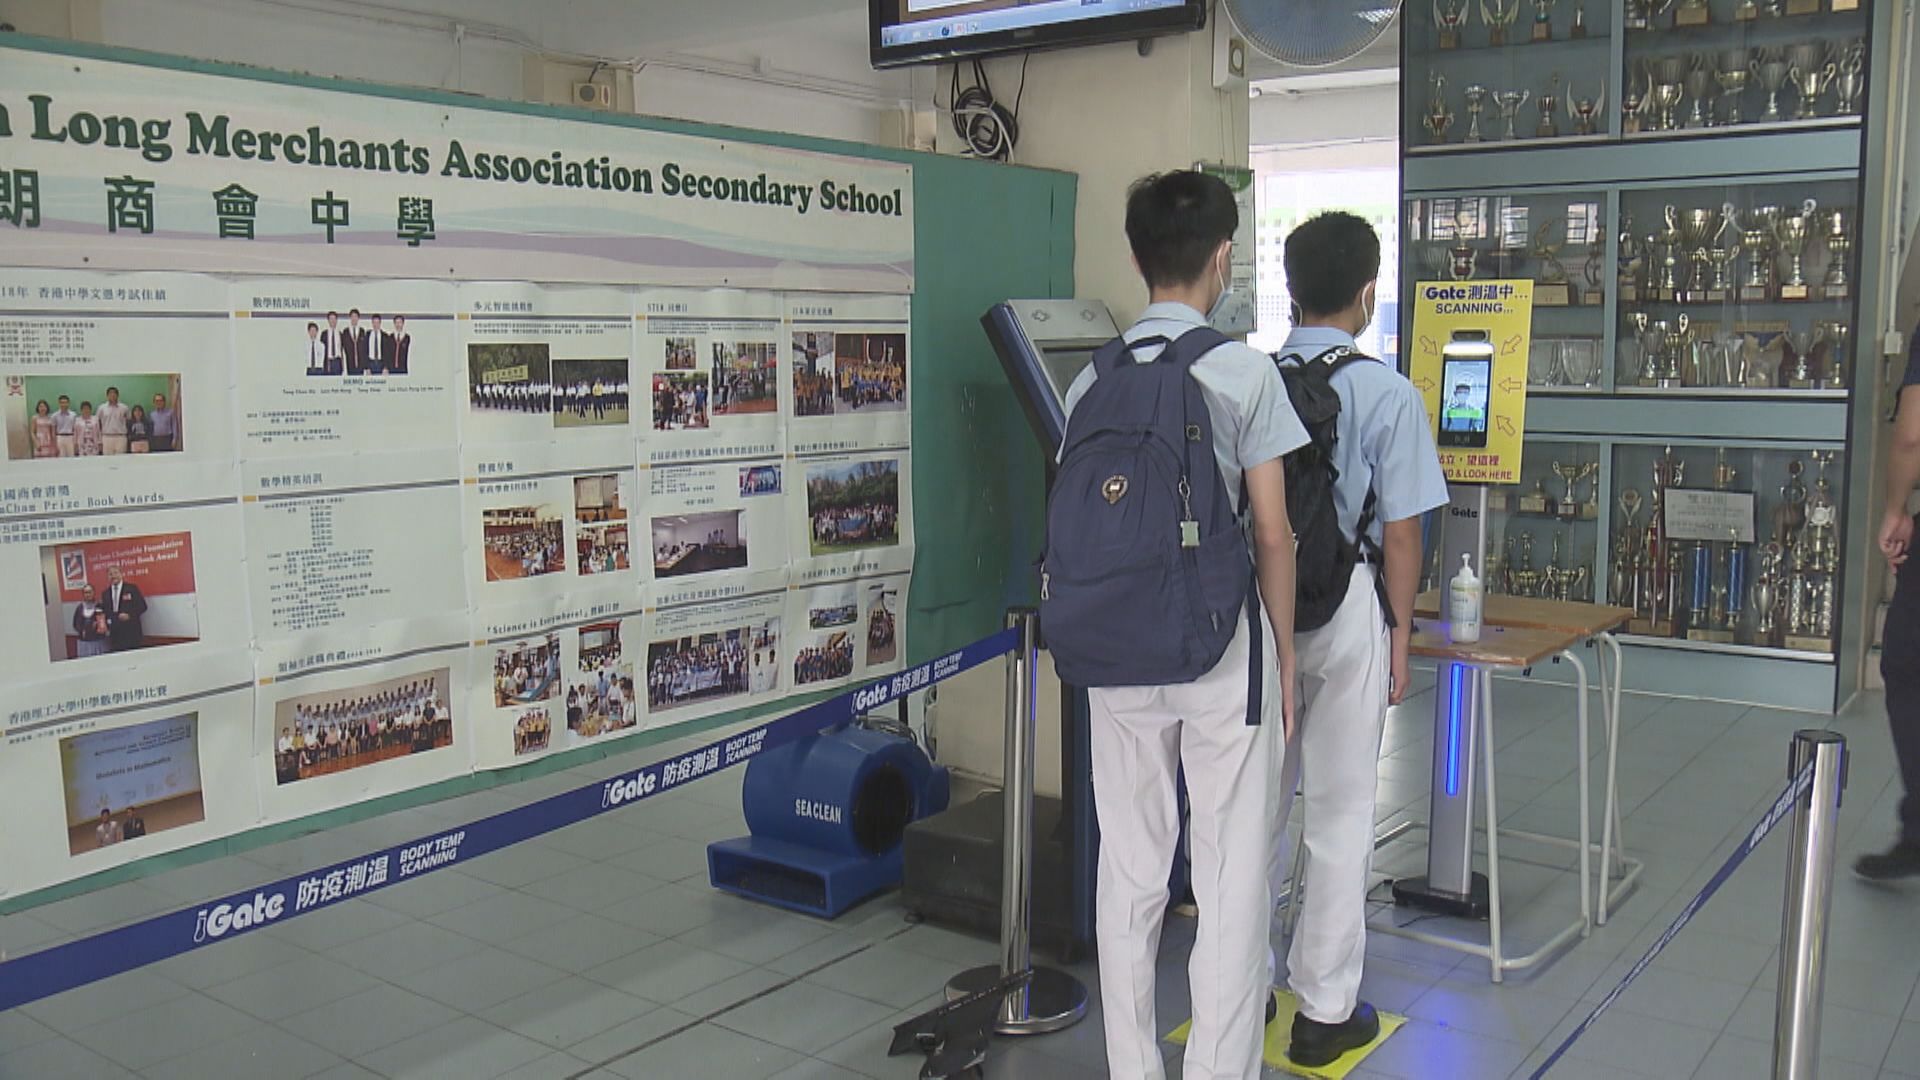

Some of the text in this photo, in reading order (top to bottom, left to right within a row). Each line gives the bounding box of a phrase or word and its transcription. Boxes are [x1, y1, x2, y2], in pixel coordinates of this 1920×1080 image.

[28, 95, 173, 162] Long
[186, 112, 429, 175] Merchants
[441, 140, 653, 195] Association
[661, 163, 812, 214] Secondary
[820, 180, 902, 216] School
[1463, 469, 1488, 479] LOOK
[1489, 470, 1512, 480] HERE
[0, 485, 70, 501] 國商會書獎
[122, 493, 164, 504] Awards
[725, 728, 768, 753] BODY TEMP
[725, 741, 762, 764] SCANNING
[399, 830, 466, 863] BODY TEMP
[399, 848, 457, 877] SCANNING
